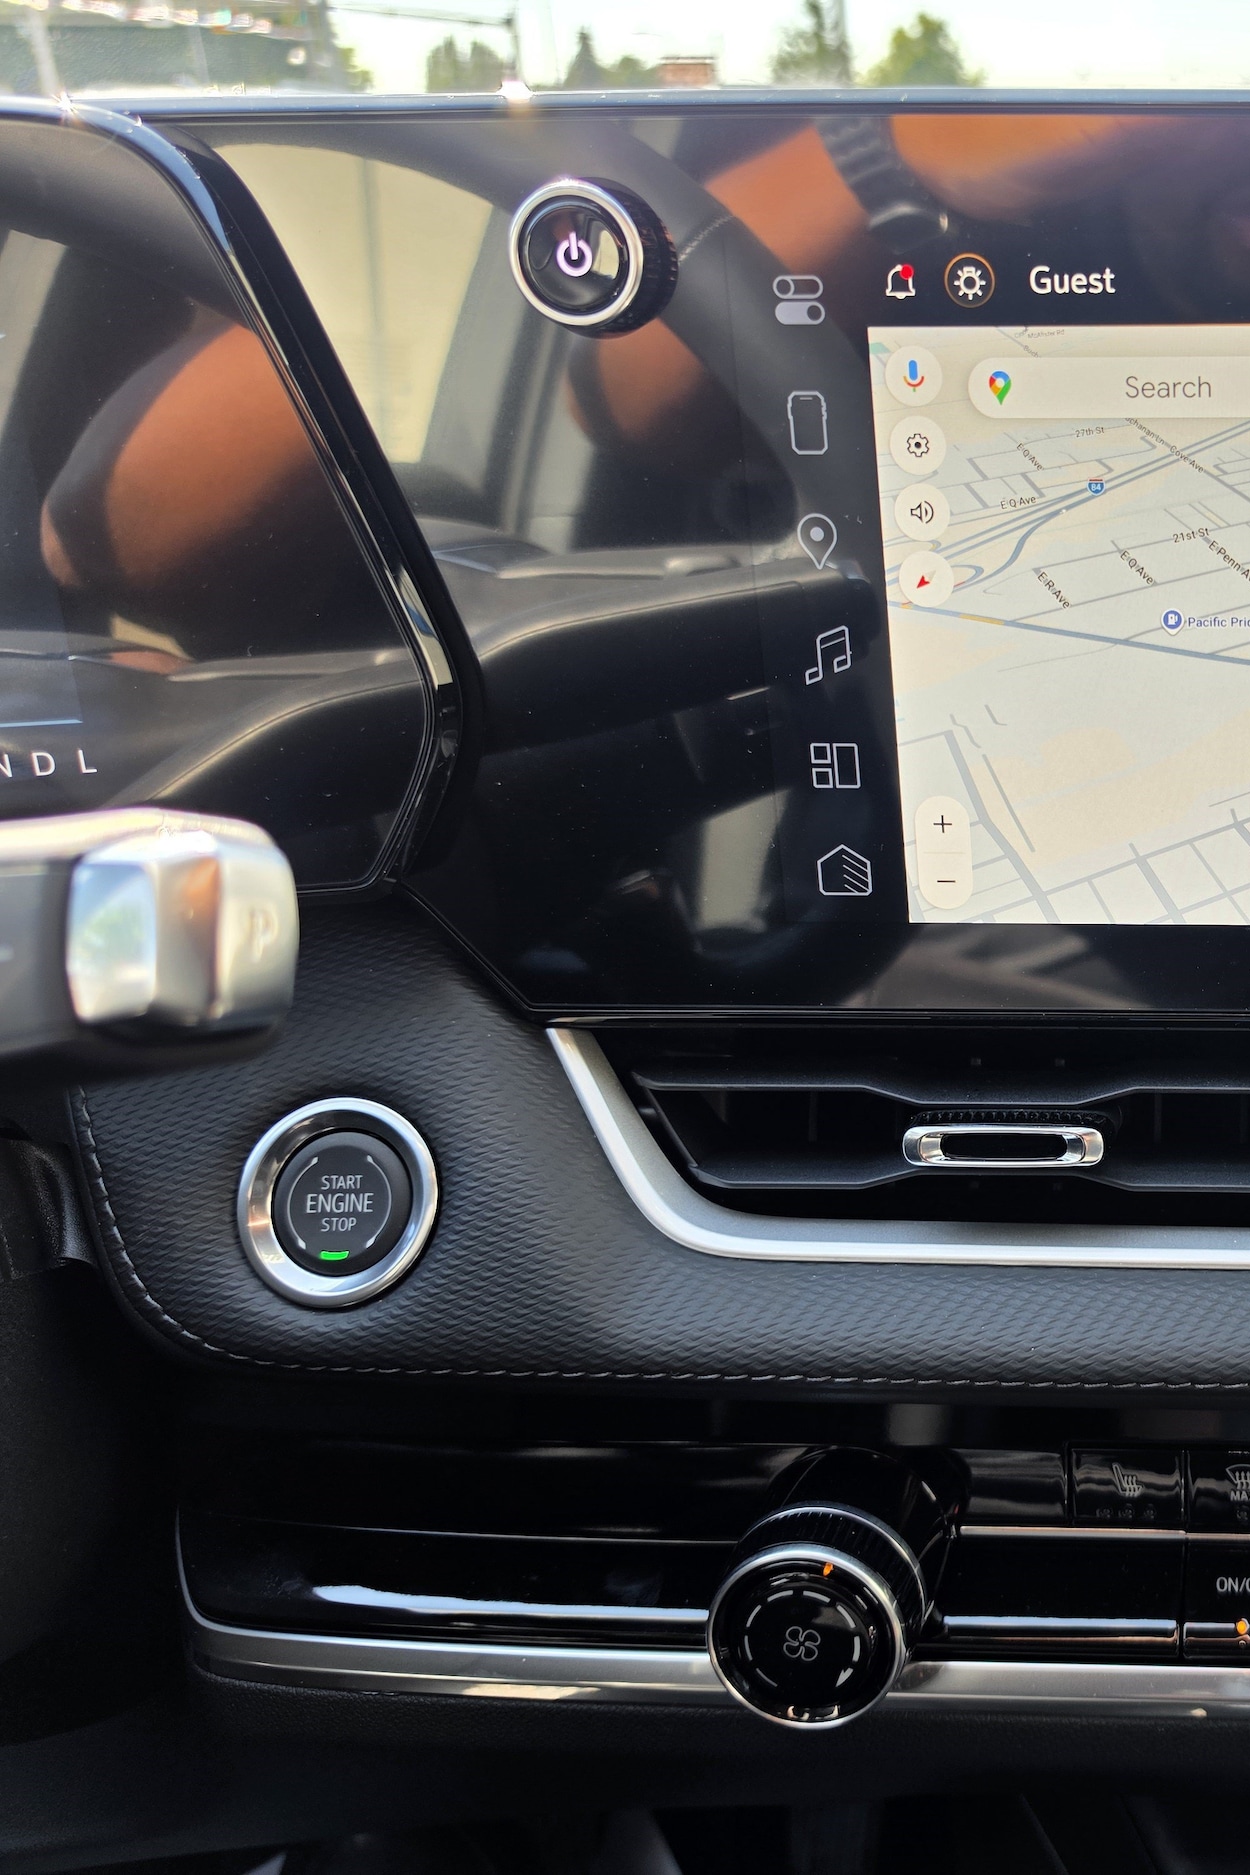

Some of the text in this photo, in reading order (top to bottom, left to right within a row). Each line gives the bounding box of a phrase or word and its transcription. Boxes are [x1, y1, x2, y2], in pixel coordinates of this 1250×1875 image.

[1029, 266, 1116, 295] Guest
[1125, 376, 1212, 399] Search
[1075, 426, 1105, 438] 27th St
[1169, 445, 1204, 473] Cove Ave
[1001, 496, 1036, 510] E Q Ave
[1173, 528, 1209, 543] 21st St
[1208, 541, 1217, 551] E
[1216, 546, 1242, 570] Penn
[1120, 550, 1154, 585] E Q Ave
[1037, 571, 1070, 609] E R Ave
[1188, 616, 1227, 628] Pacific
[31, 751, 56, 777] D
[78, 749, 98, 774] L
[321, 1175, 363, 1190] START
[306, 1192, 374, 1214] ENGINE
[320, 1217, 357, 1232] STOP
